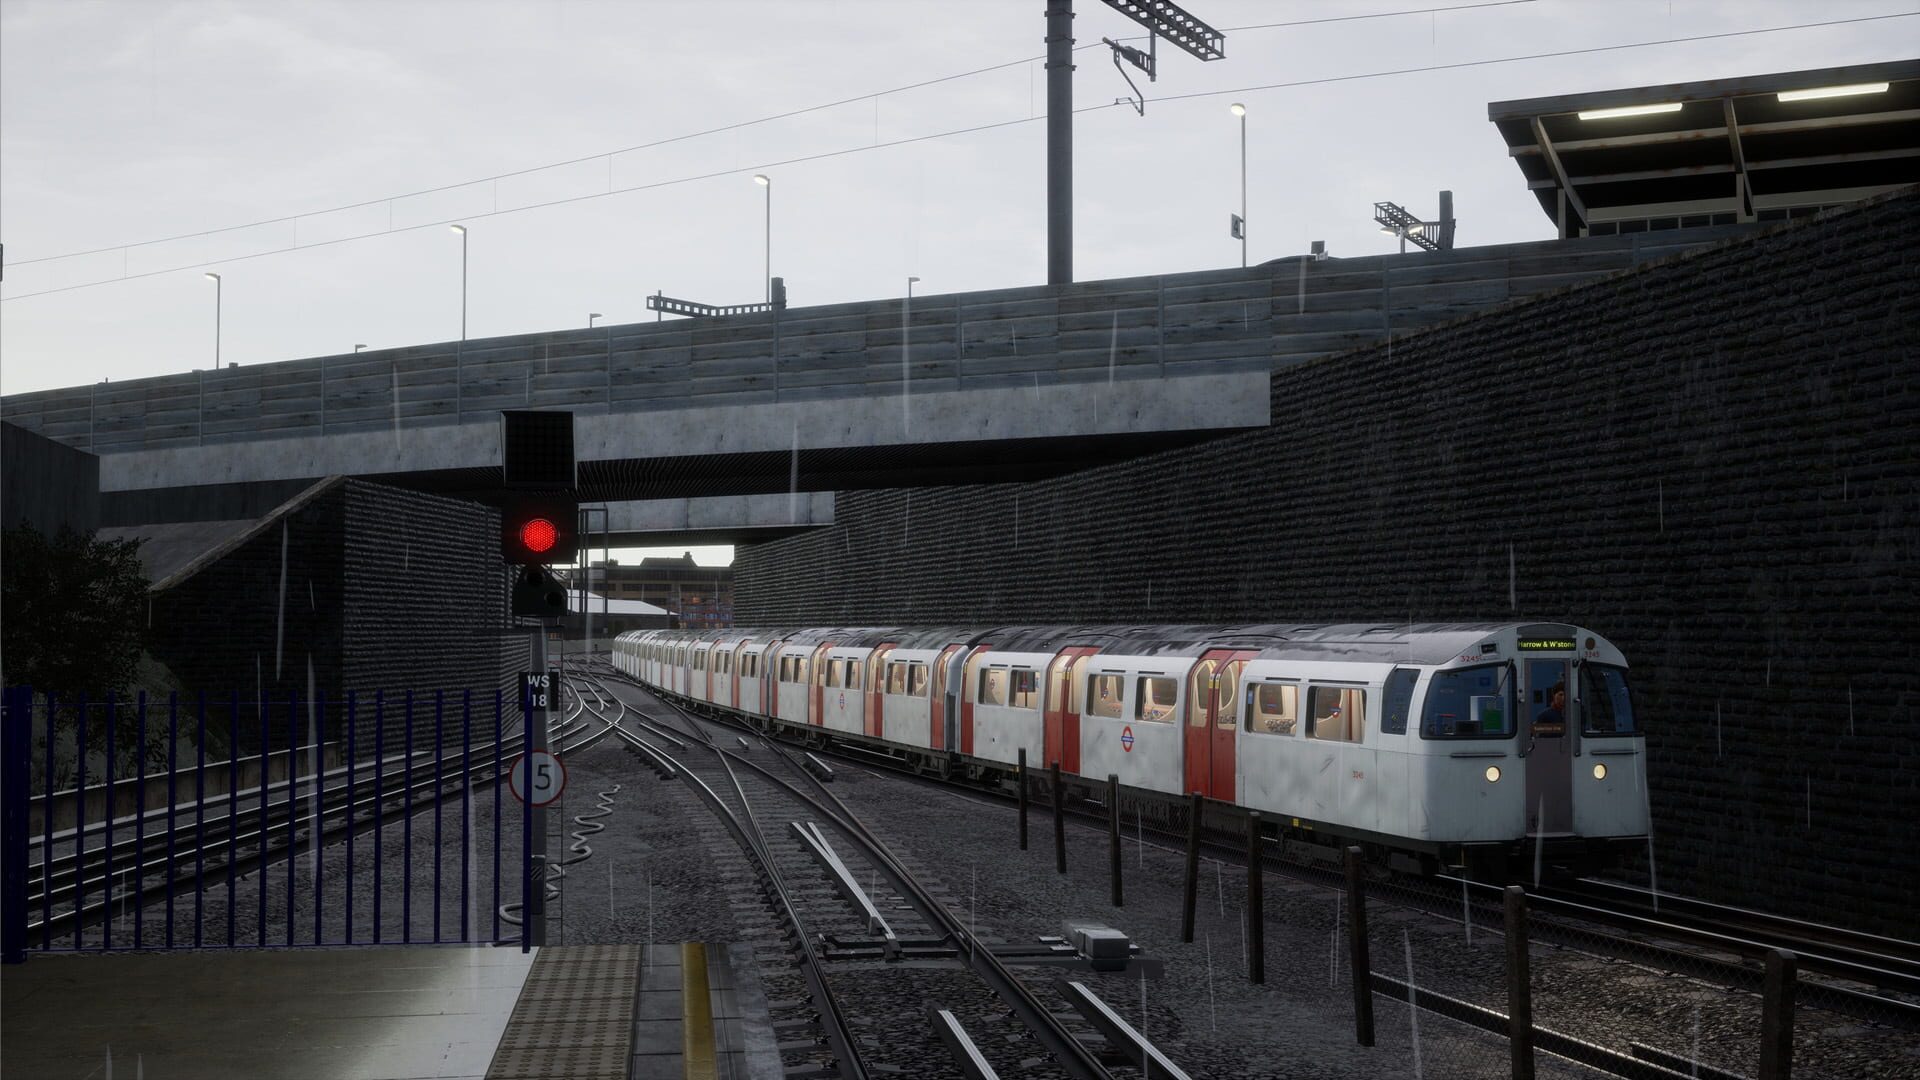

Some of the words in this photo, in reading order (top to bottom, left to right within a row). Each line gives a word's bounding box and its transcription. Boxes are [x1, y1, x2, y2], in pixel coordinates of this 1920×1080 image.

[527, 675, 550, 688] WS
[532, 694, 547, 707] 18
[534, 764, 551, 790] 5
